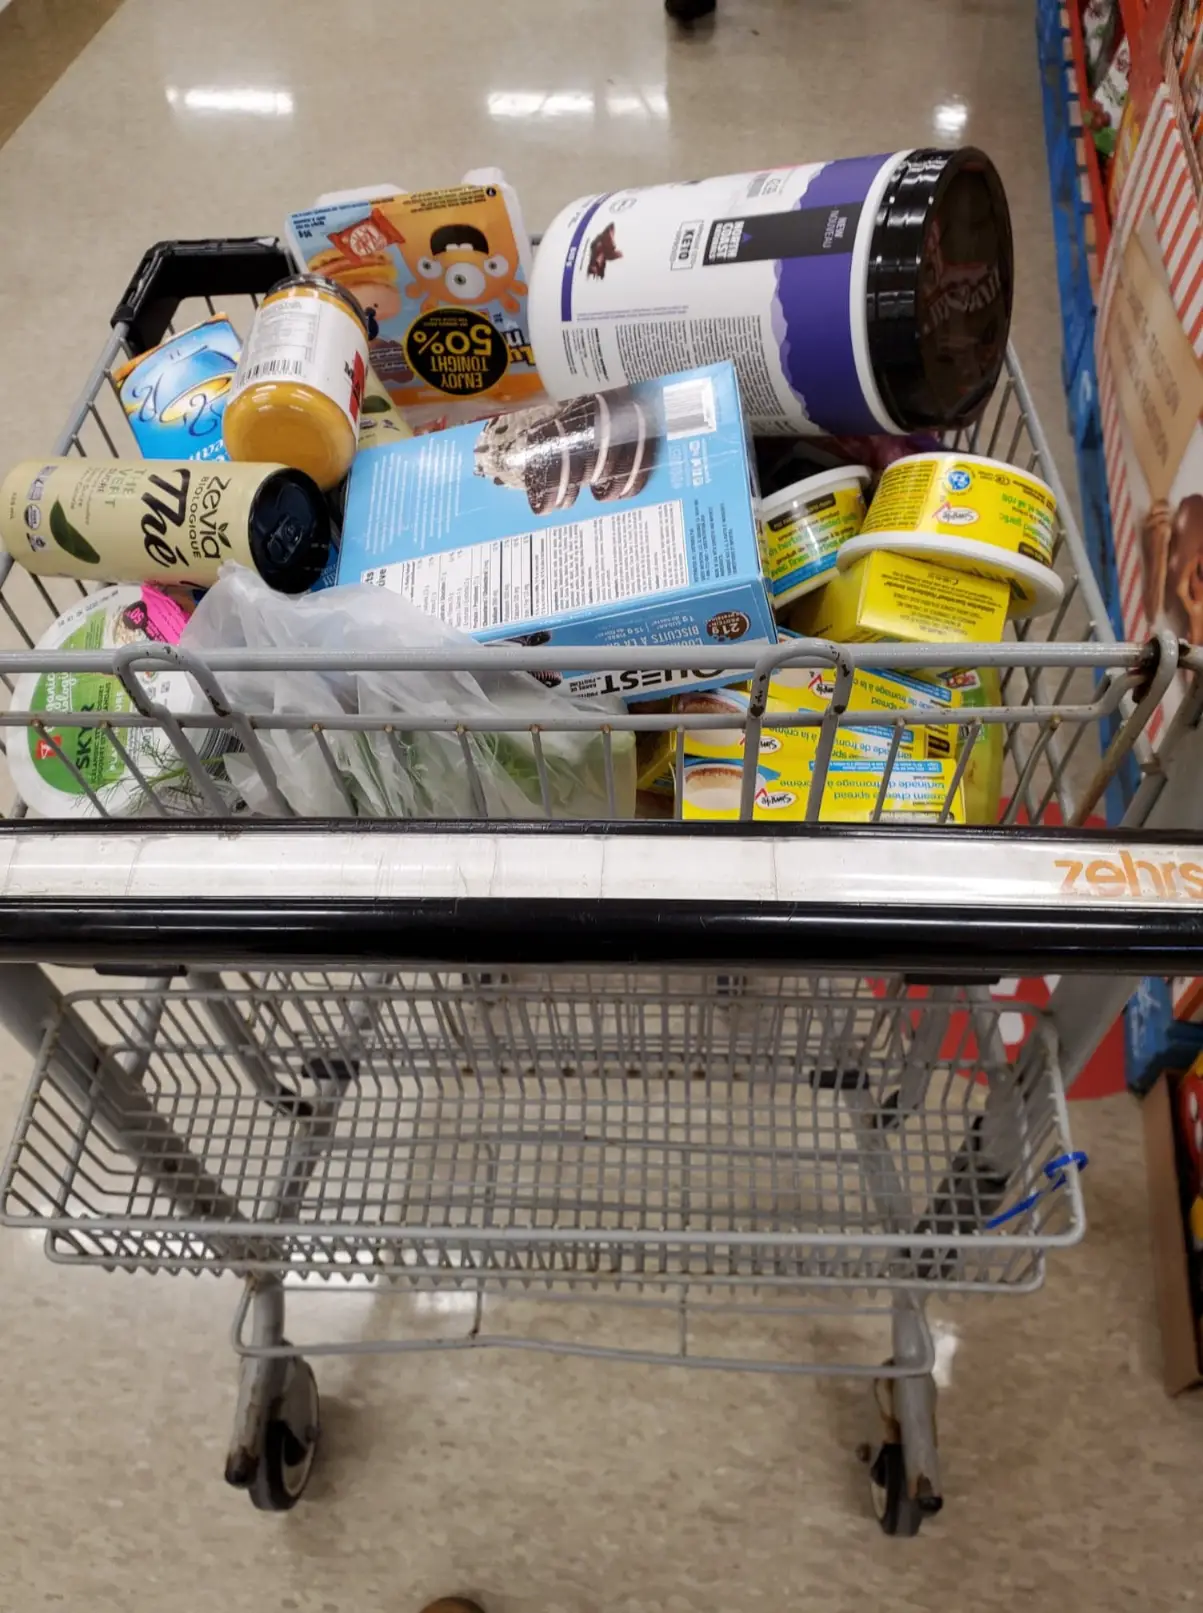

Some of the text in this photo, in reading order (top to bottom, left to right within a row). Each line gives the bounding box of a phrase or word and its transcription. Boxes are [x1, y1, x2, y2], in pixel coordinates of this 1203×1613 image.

[822, 209, 840, 249] NOUVEAU
[678, 229, 697, 260] KETO
[413, 323, 493, 357] 50%
[430, 355, 489, 373] TONIGHT
[441, 372, 484, 389] ENJOY
[140, 468, 191, 568] Thé
[189, 476, 209, 559] BIOLOGIQUE
[941, 510, 975, 522] Simple
[650, 624, 700, 645] BISCUITS
[722, 622, 740, 635] 21
[601, 668, 724, 695] UEST
[870, 696, 898, 710] spread
[761, 794, 792, 805] Simple
[833, 791, 871, 801] spread
[912, 791, 947, 801] cream
[1053, 849, 1203, 900] zehrs
